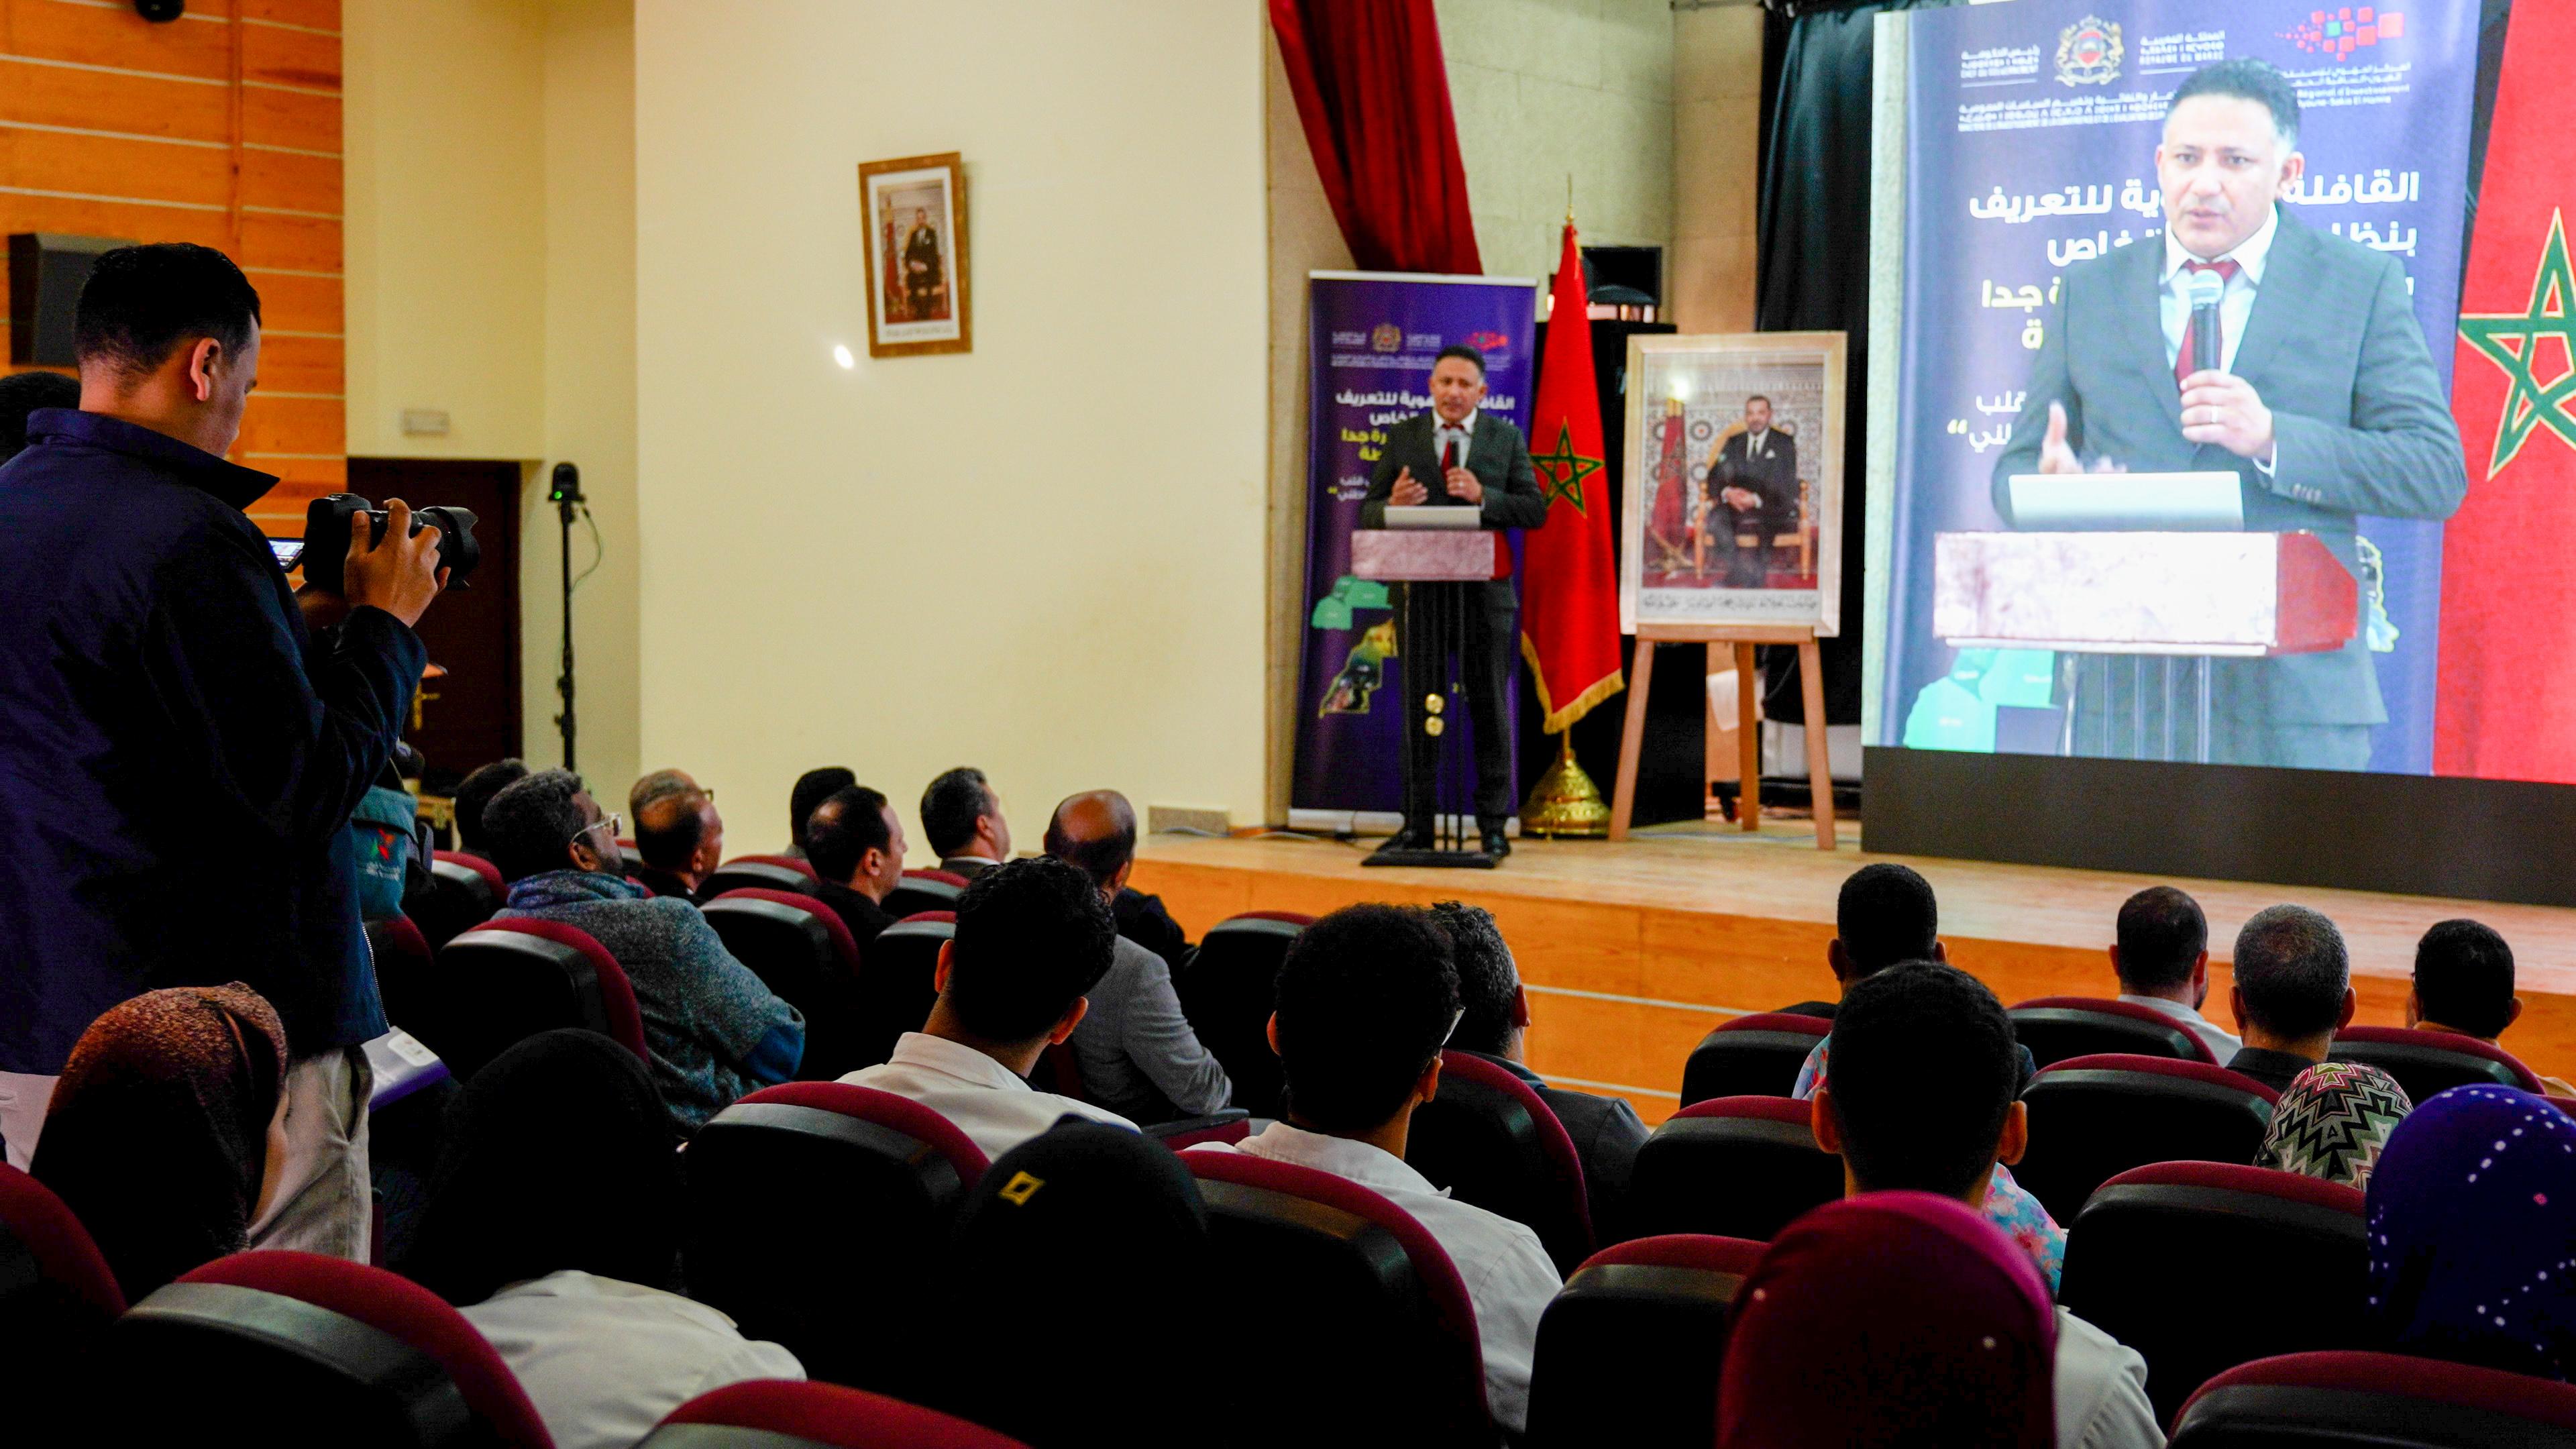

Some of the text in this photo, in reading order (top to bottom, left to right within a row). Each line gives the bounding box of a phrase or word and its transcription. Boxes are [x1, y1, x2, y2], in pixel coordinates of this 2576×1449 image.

[1970, 184, 2113, 223] للتعريف
[2282, 169, 2420, 205] القافلة
[1982, 279, 2043, 313] جدا
